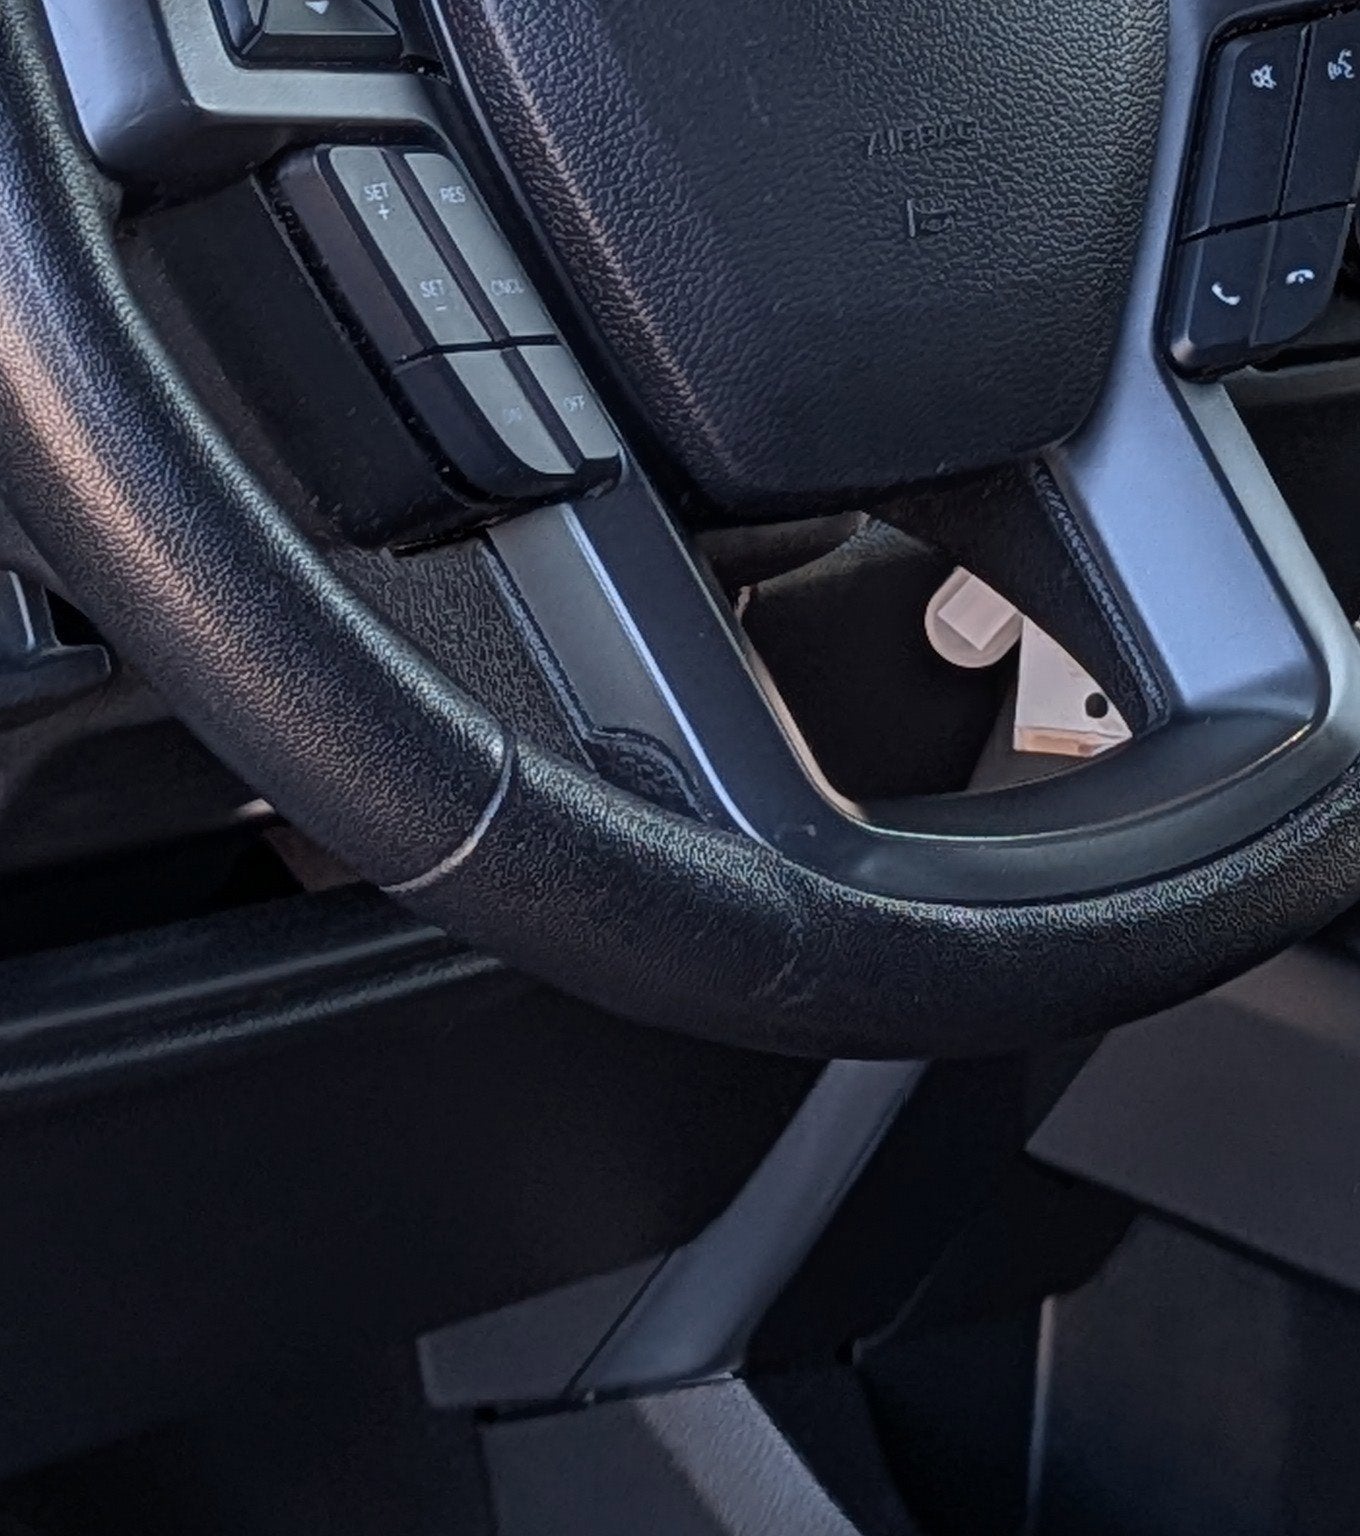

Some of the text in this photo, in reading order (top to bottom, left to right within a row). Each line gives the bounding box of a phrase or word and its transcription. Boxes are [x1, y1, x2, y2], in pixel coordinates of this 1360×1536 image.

[364, 182, 389, 201] SET
[440, 185, 466, 203] RES
[419, 279, 444, 297] SET
